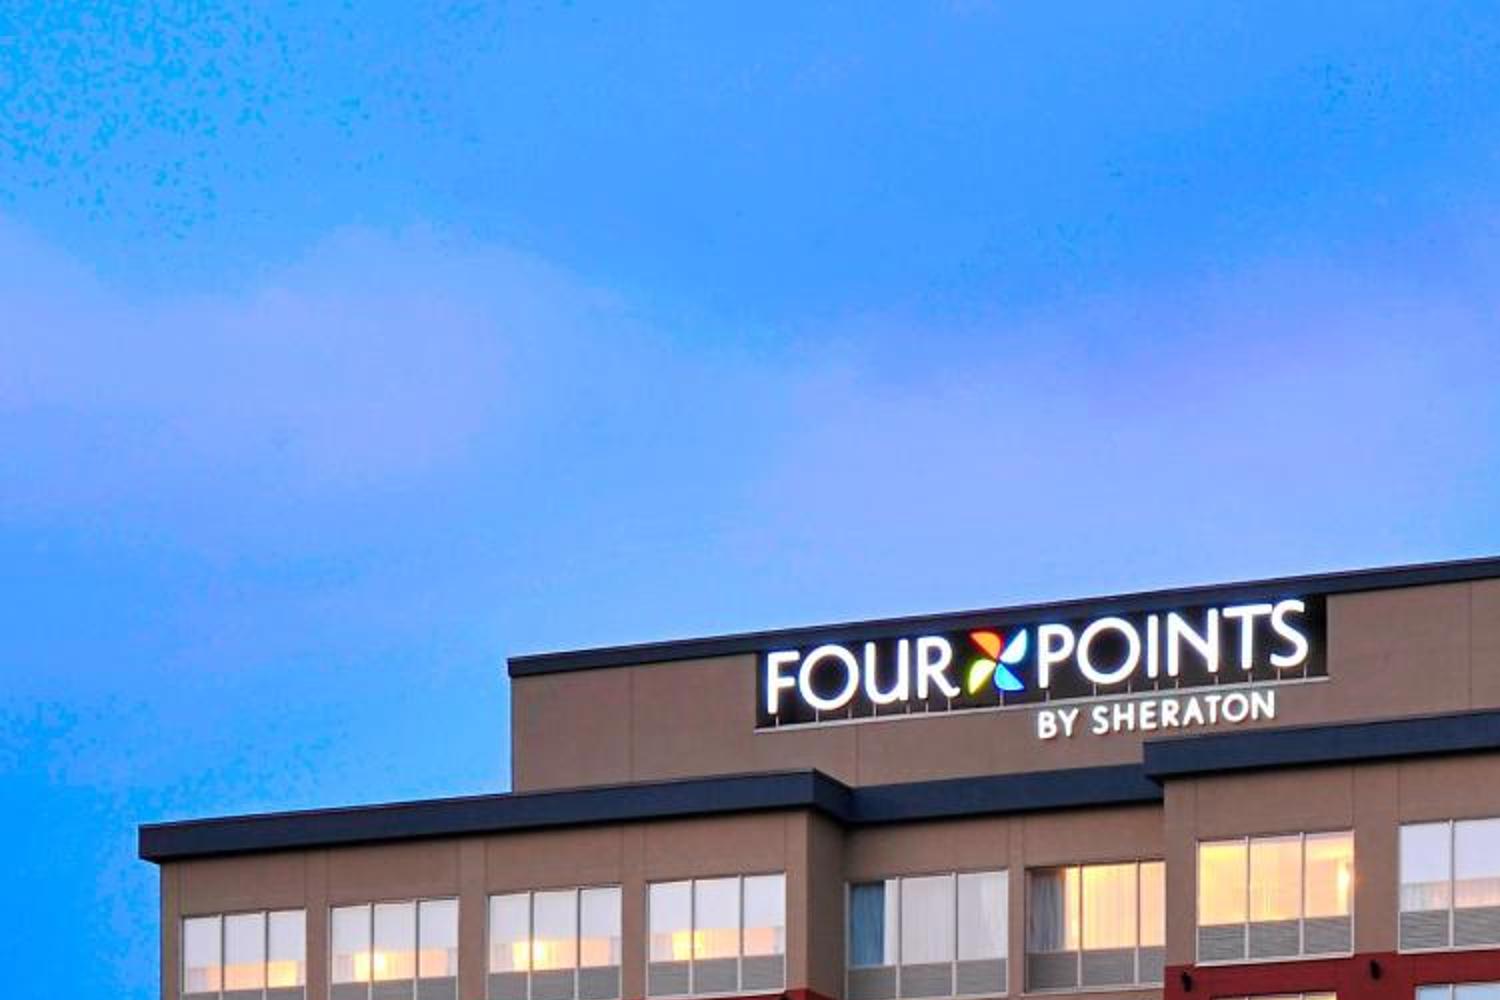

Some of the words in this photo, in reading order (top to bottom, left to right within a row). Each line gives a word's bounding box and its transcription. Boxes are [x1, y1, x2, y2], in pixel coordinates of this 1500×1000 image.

[766, 635, 961, 715] FOUR
[1038, 599, 1309, 689] POINTS
[1038, 707, 1079, 740] BY
[1091, 690, 1276, 735] SHERATON
